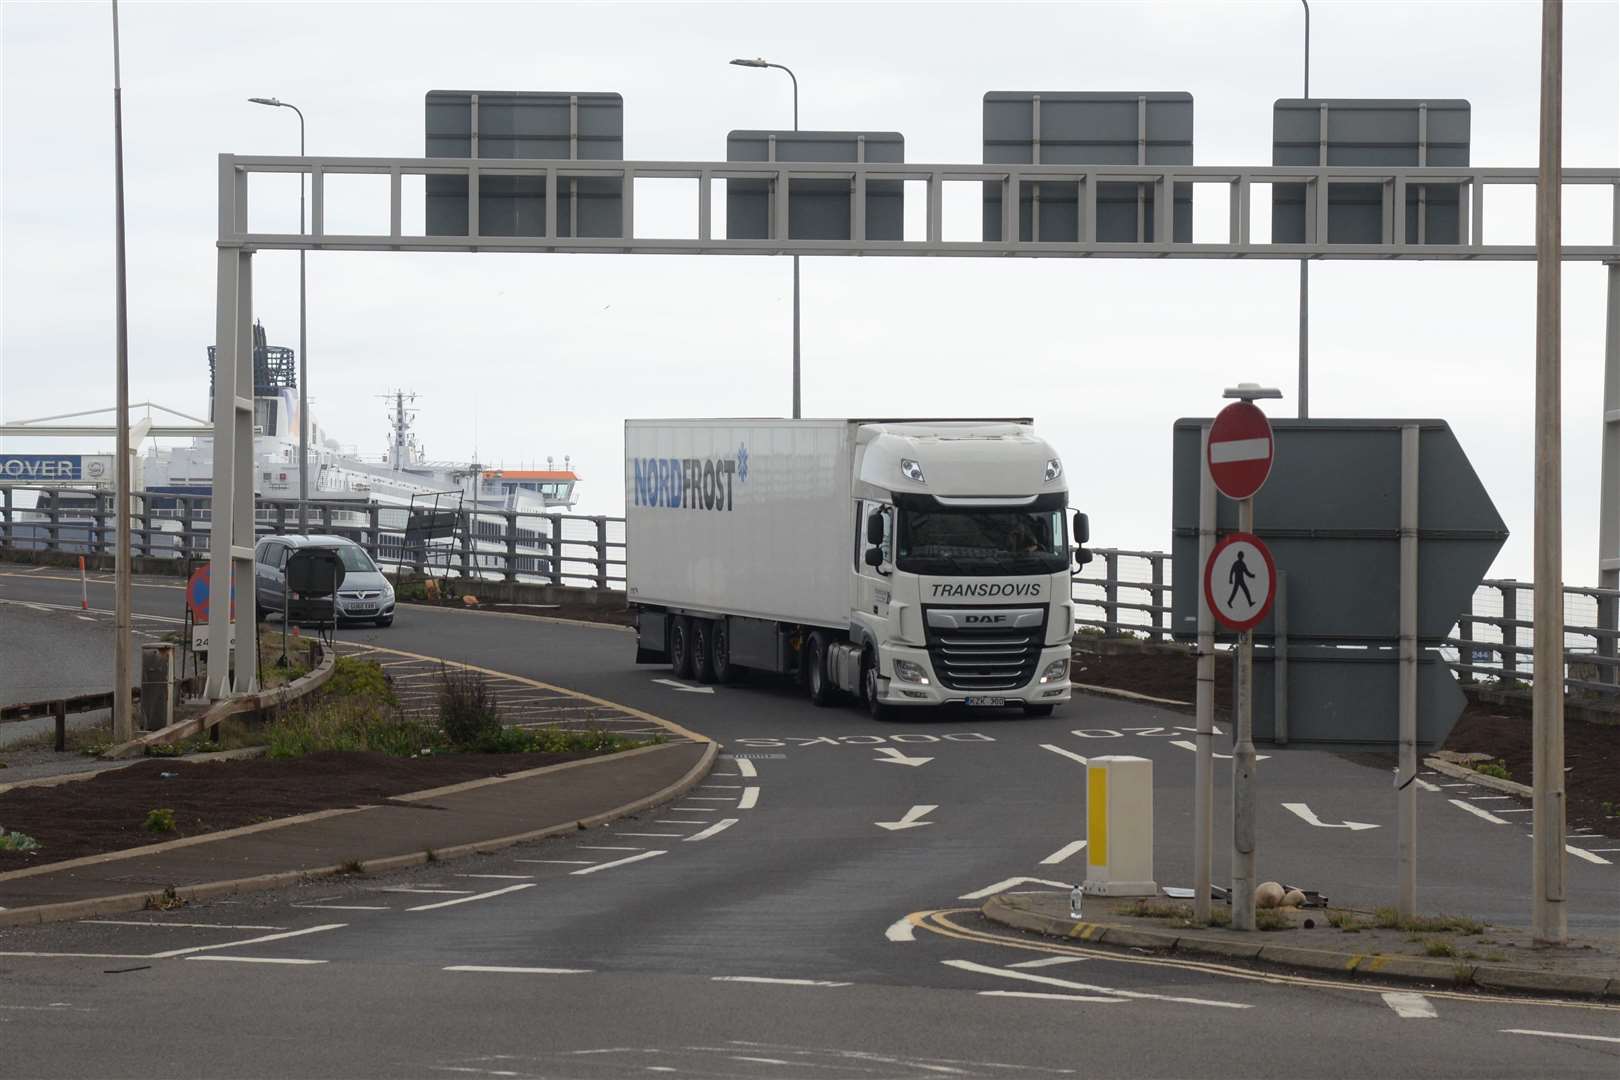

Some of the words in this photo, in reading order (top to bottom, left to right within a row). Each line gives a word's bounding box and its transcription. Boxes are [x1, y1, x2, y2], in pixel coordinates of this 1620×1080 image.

[0, 459, 73, 476] OVER
[634, 457, 735, 511] NORDFROST
[932, 583, 1041, 596] TRANSDOVIS
[965, 615, 1007, 623] DAF
[735, 732, 997, 747] DOCKS
